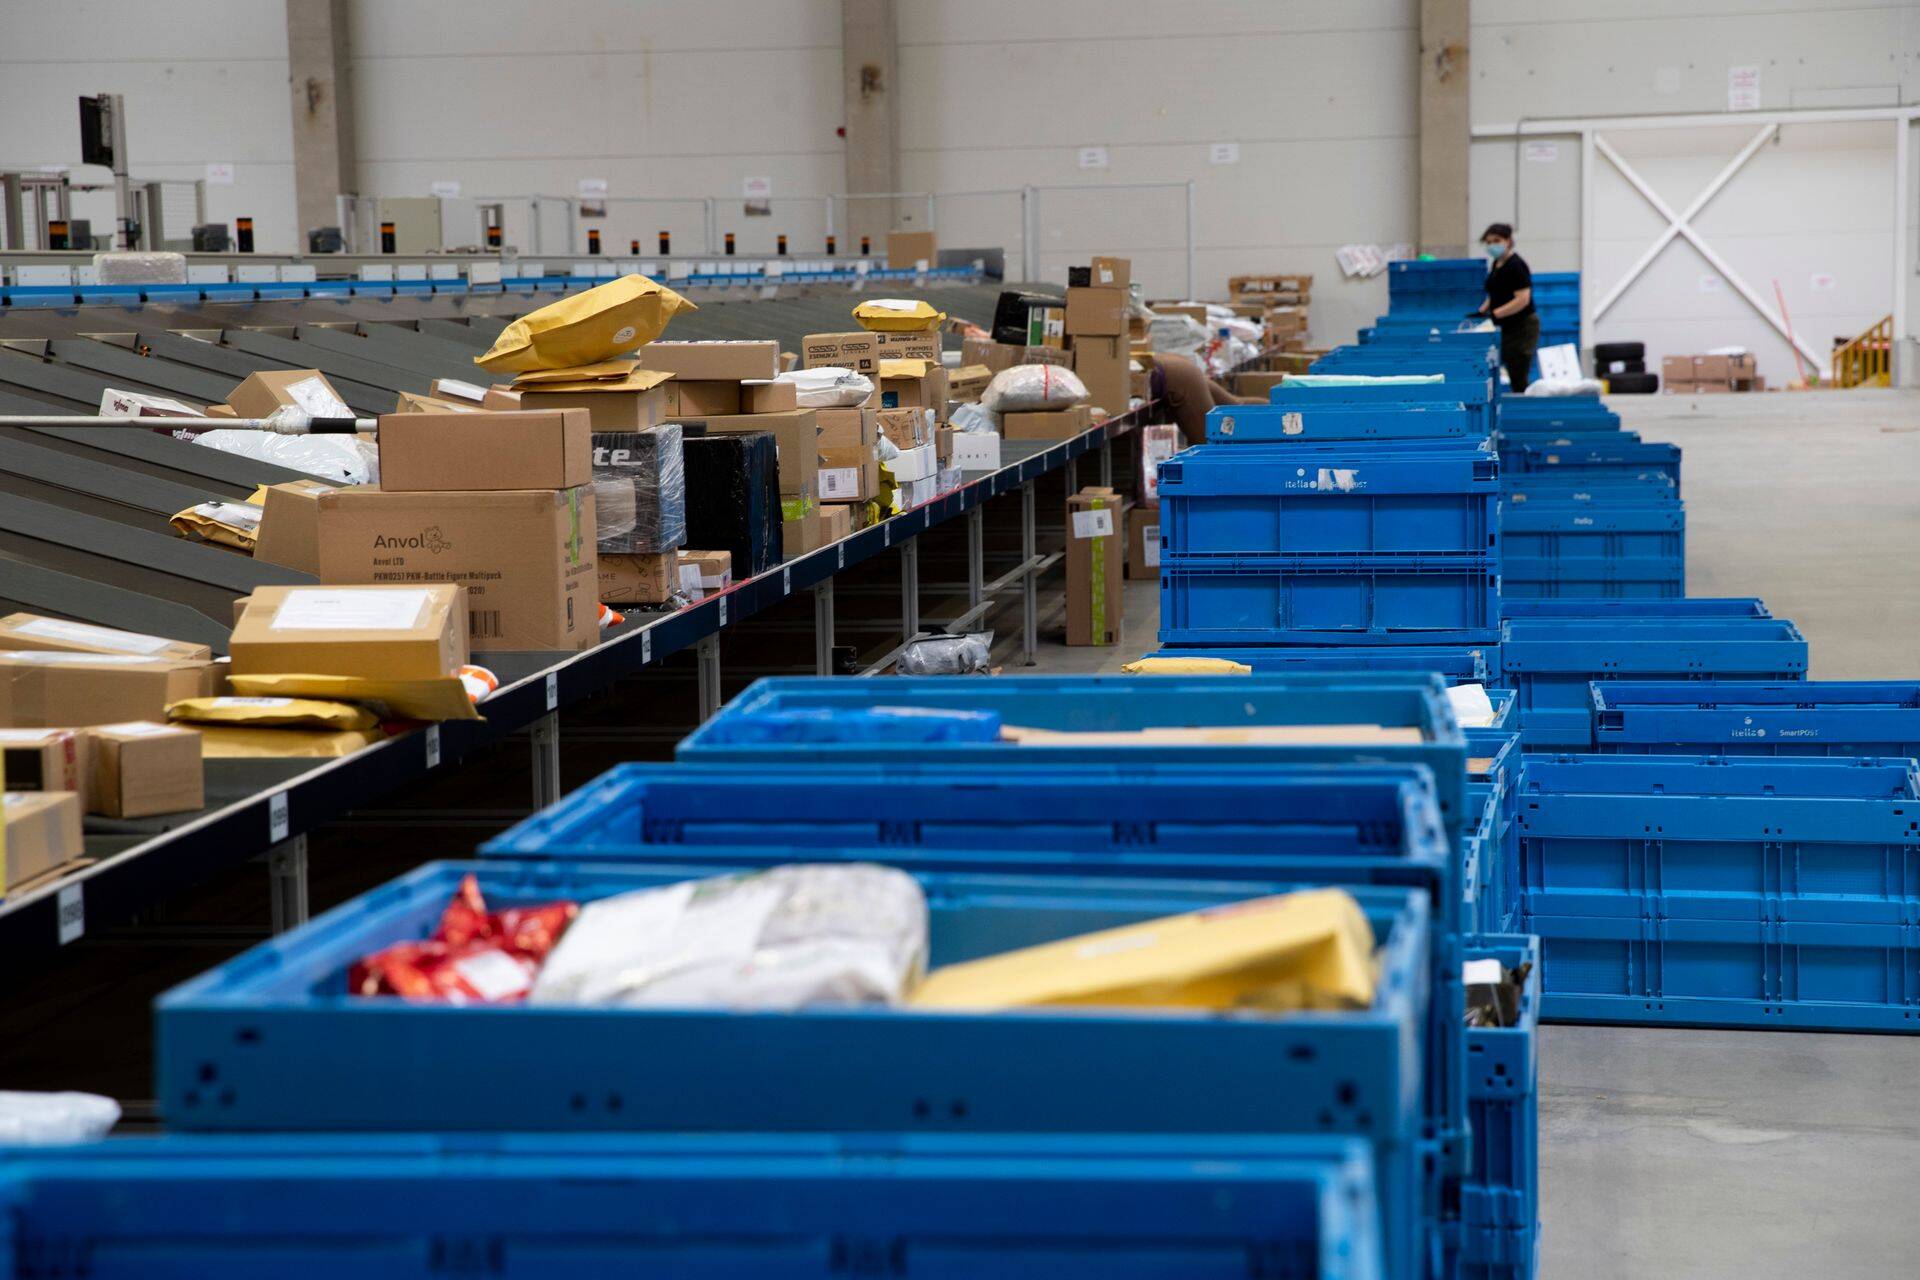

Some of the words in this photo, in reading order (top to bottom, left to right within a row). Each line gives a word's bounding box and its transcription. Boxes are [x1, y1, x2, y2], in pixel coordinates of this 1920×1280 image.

[373, 533, 425, 549] Anvol
[373, 558, 391, 566] Anvol
[392, 558, 404, 566] LTD
[446, 572, 468, 582] Figure
[468, 571, 502, 581] Multipack
[1779, 729, 1819, 737] SmartPOST
